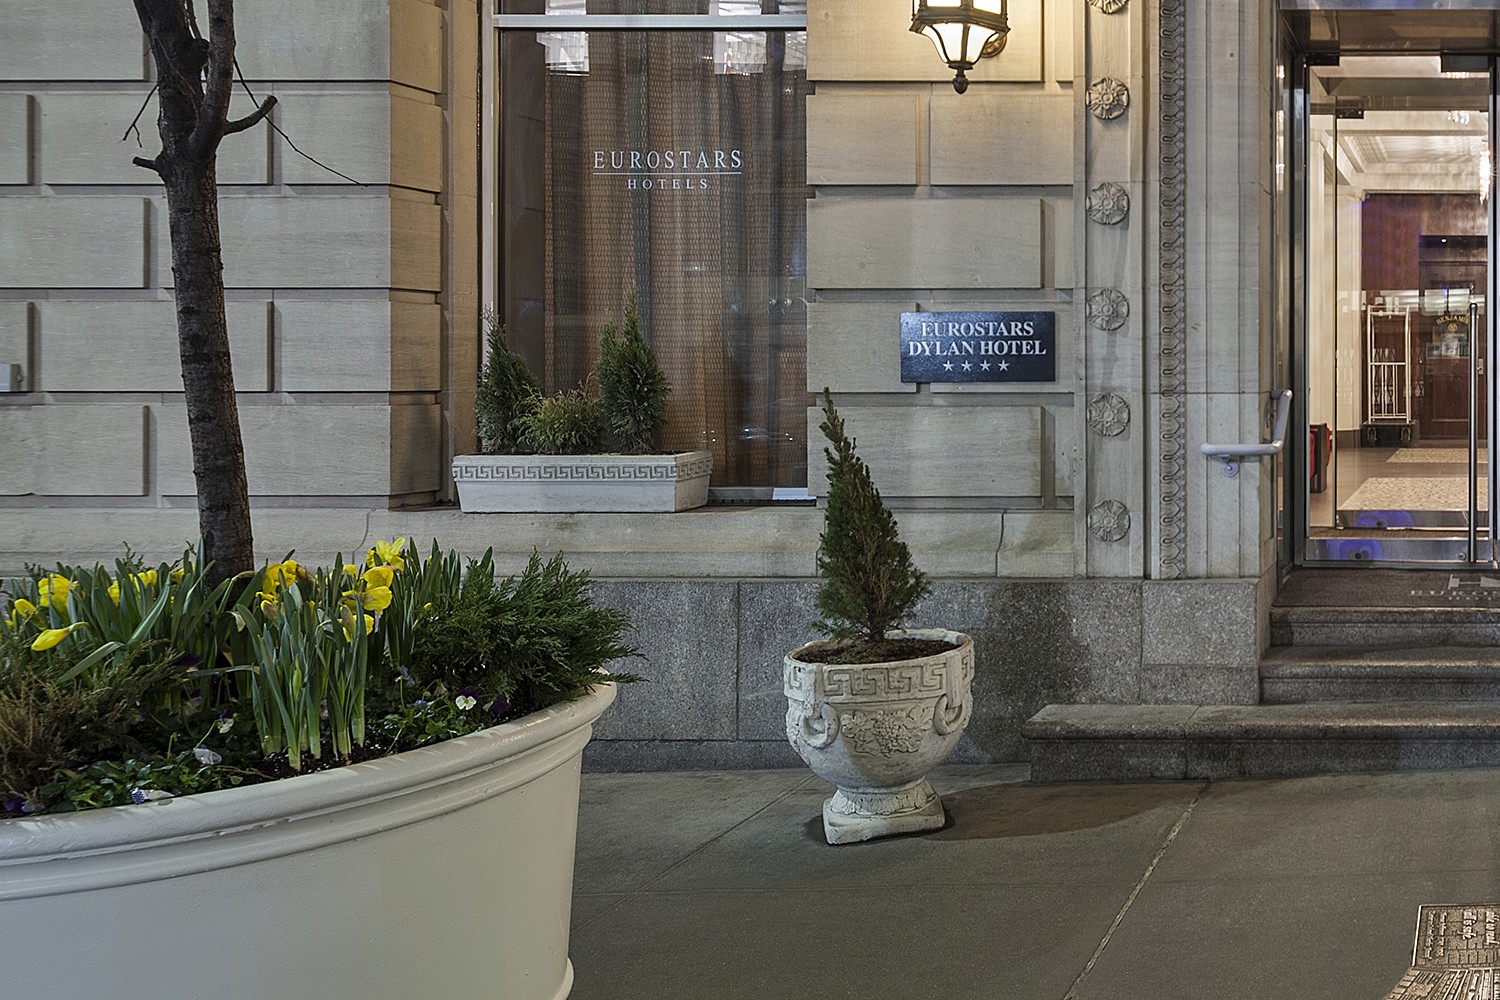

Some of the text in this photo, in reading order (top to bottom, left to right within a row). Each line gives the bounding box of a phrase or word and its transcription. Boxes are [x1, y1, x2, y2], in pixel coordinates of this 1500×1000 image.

[593, 149, 744, 169] EUROSTARS
[627, 178, 709, 190] HOTELS
[921, 321, 1034, 337] EUROSTARS
[909, 340, 1047, 356] DYLAN HOTEL
